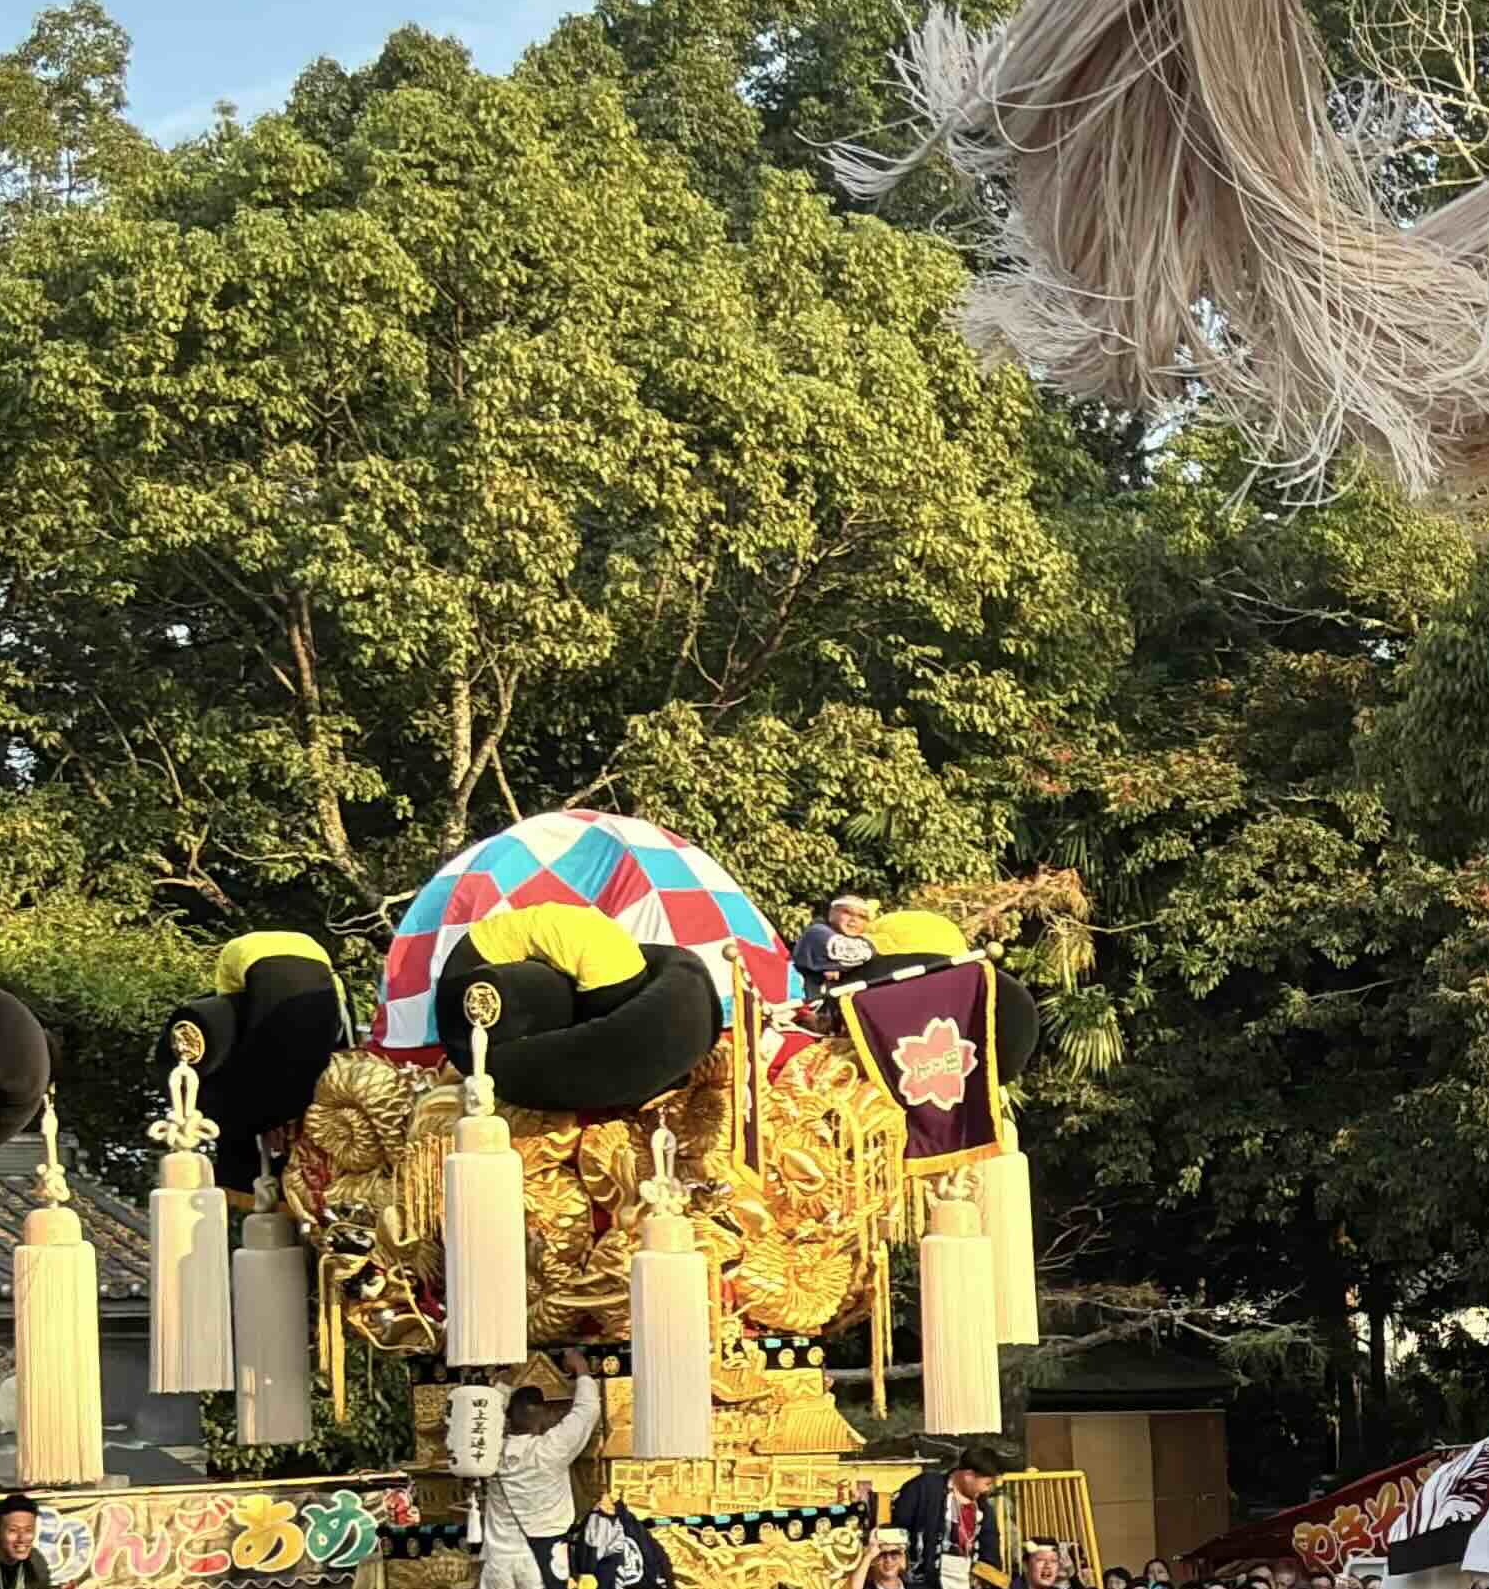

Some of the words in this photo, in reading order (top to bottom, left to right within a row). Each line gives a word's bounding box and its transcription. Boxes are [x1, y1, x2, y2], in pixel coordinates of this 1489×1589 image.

[38, 1489, 379, 1585] りんごあめ
